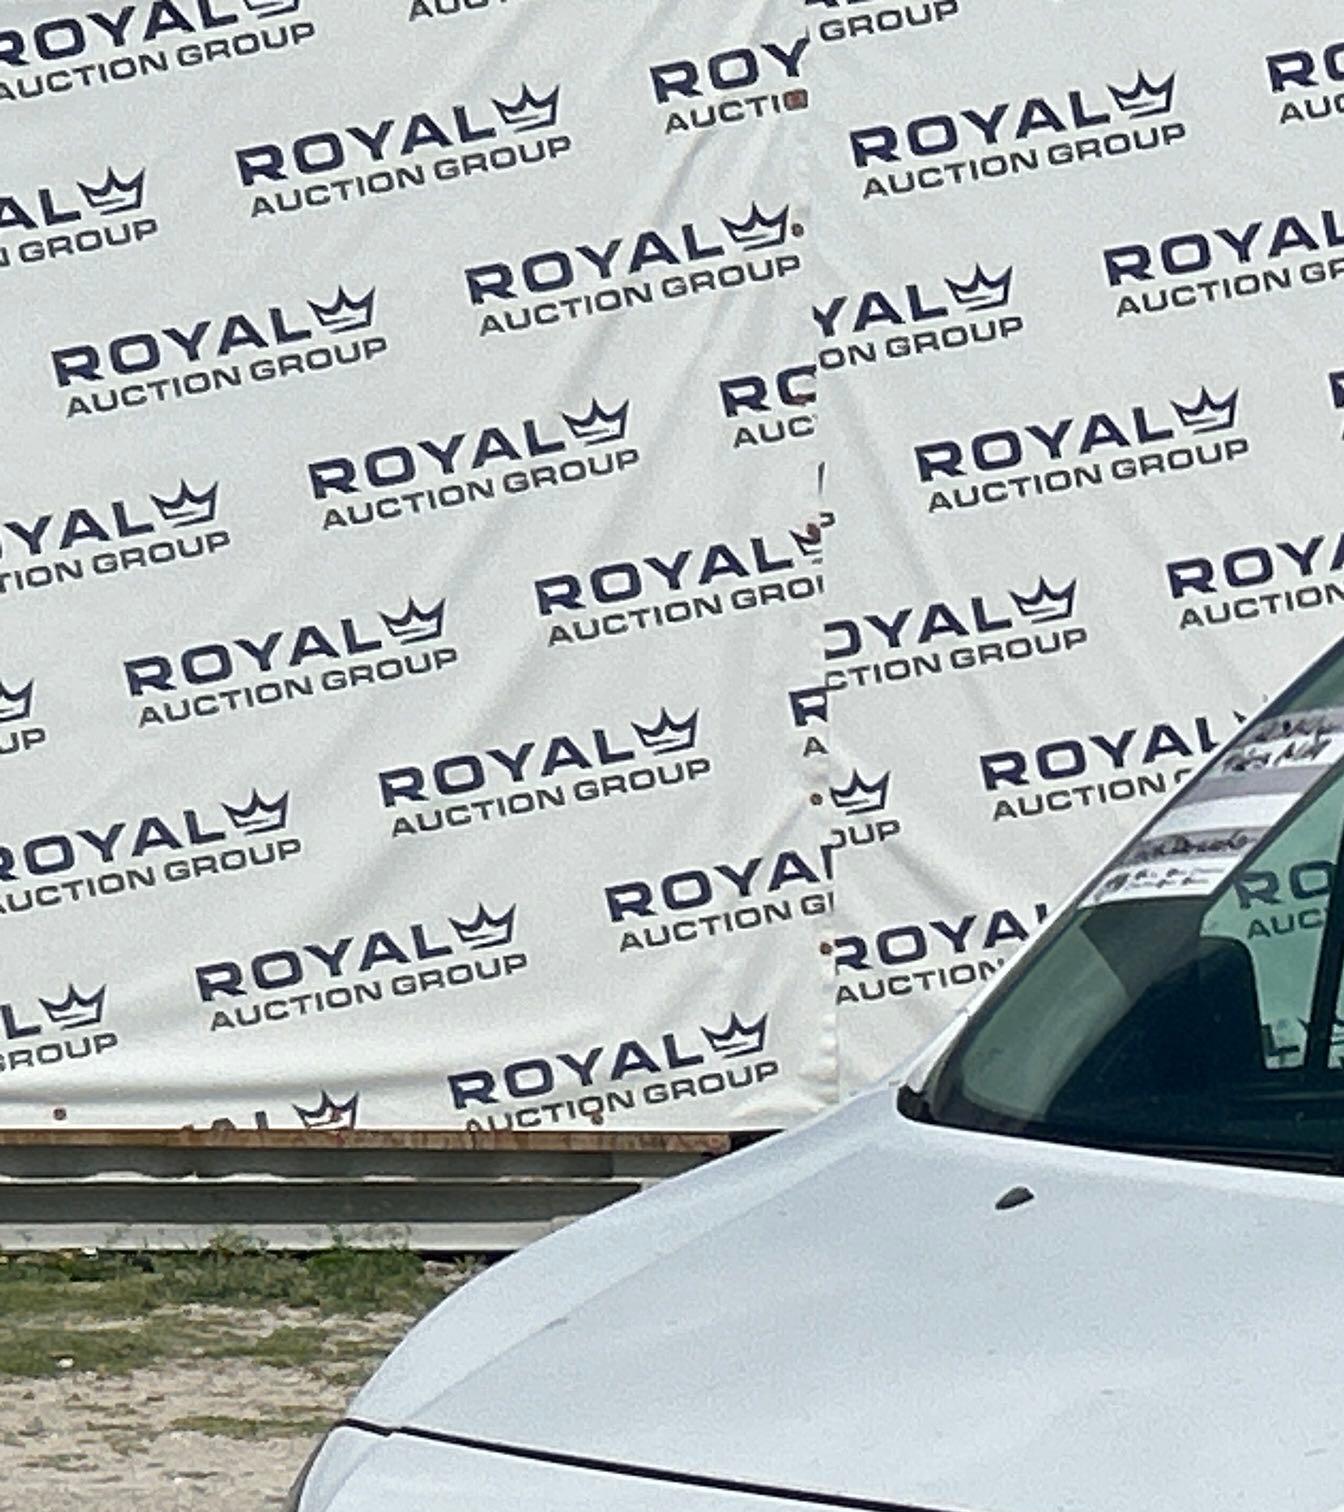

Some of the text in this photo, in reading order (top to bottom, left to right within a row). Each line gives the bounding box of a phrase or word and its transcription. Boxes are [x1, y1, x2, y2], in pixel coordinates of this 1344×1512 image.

[176, 22, 315, 66] GROUP
[819, 0, 959, 42] GROUP
[649, 38, 810, 104] ROY
[235, 106, 497, 187] ROYAL
[849, 90, 1111, 168] ROYAL
[863, 123, 1186, 200] AUCTION GROUP
[251, 136, 571, 218] AUCTION GROUP
[18, 218, 158, 264] GROUP
[464, 223, 725, 306] ROYAL
[480, 255, 800, 337] AUCTION GROUP
[811, 284, 949, 339] YAL
[1116, 268, 1291, 318] AUCTION
[51, 307, 312, 388] ROYAL
[885, 317, 1023, 358] GROUP
[67, 337, 387, 418] AUCTION GROUP
[308, 419, 567, 500] ROYAL
[914, 407, 1174, 483] ROYAL
[928, 438, 1249, 513] AUCTION GROUP
[323, 449, 639, 531] AUCTION GROUP
[0, 531, 230, 594] TION GROUP
[1, 501, 156, 556] YAL
[534, 537, 795, 616] ROYAL
[548, 575, 823, 647] AUCTION GRO
[123, 618, 382, 697] ROYAL
[824, 596, 1013, 661] OYAL
[824, 628, 1087, 691] CTION GROUP
[139, 648, 457, 728] AUCTION GROUP
[378, 729, 635, 808] ROYAL
[980, 717, 1219, 791] ROYAL
[392, 759, 710, 838] AUCTION GROUP
[831, 819, 901, 850] OUP
[992, 772, 1167, 822] AUCTION
[0, 839, 301, 914] UCTION GROUP
[195, 924, 454, 1003] ROYAL
[620, 900, 792, 952] AUCTION
[210, 953, 527, 1031] AUCTION GROUP
[0, 1032, 118, 1073] ROUP
[447, 1033, 704, 1110] ROYAL
[464, 1061, 778, 1131] AUCTION GROUP
